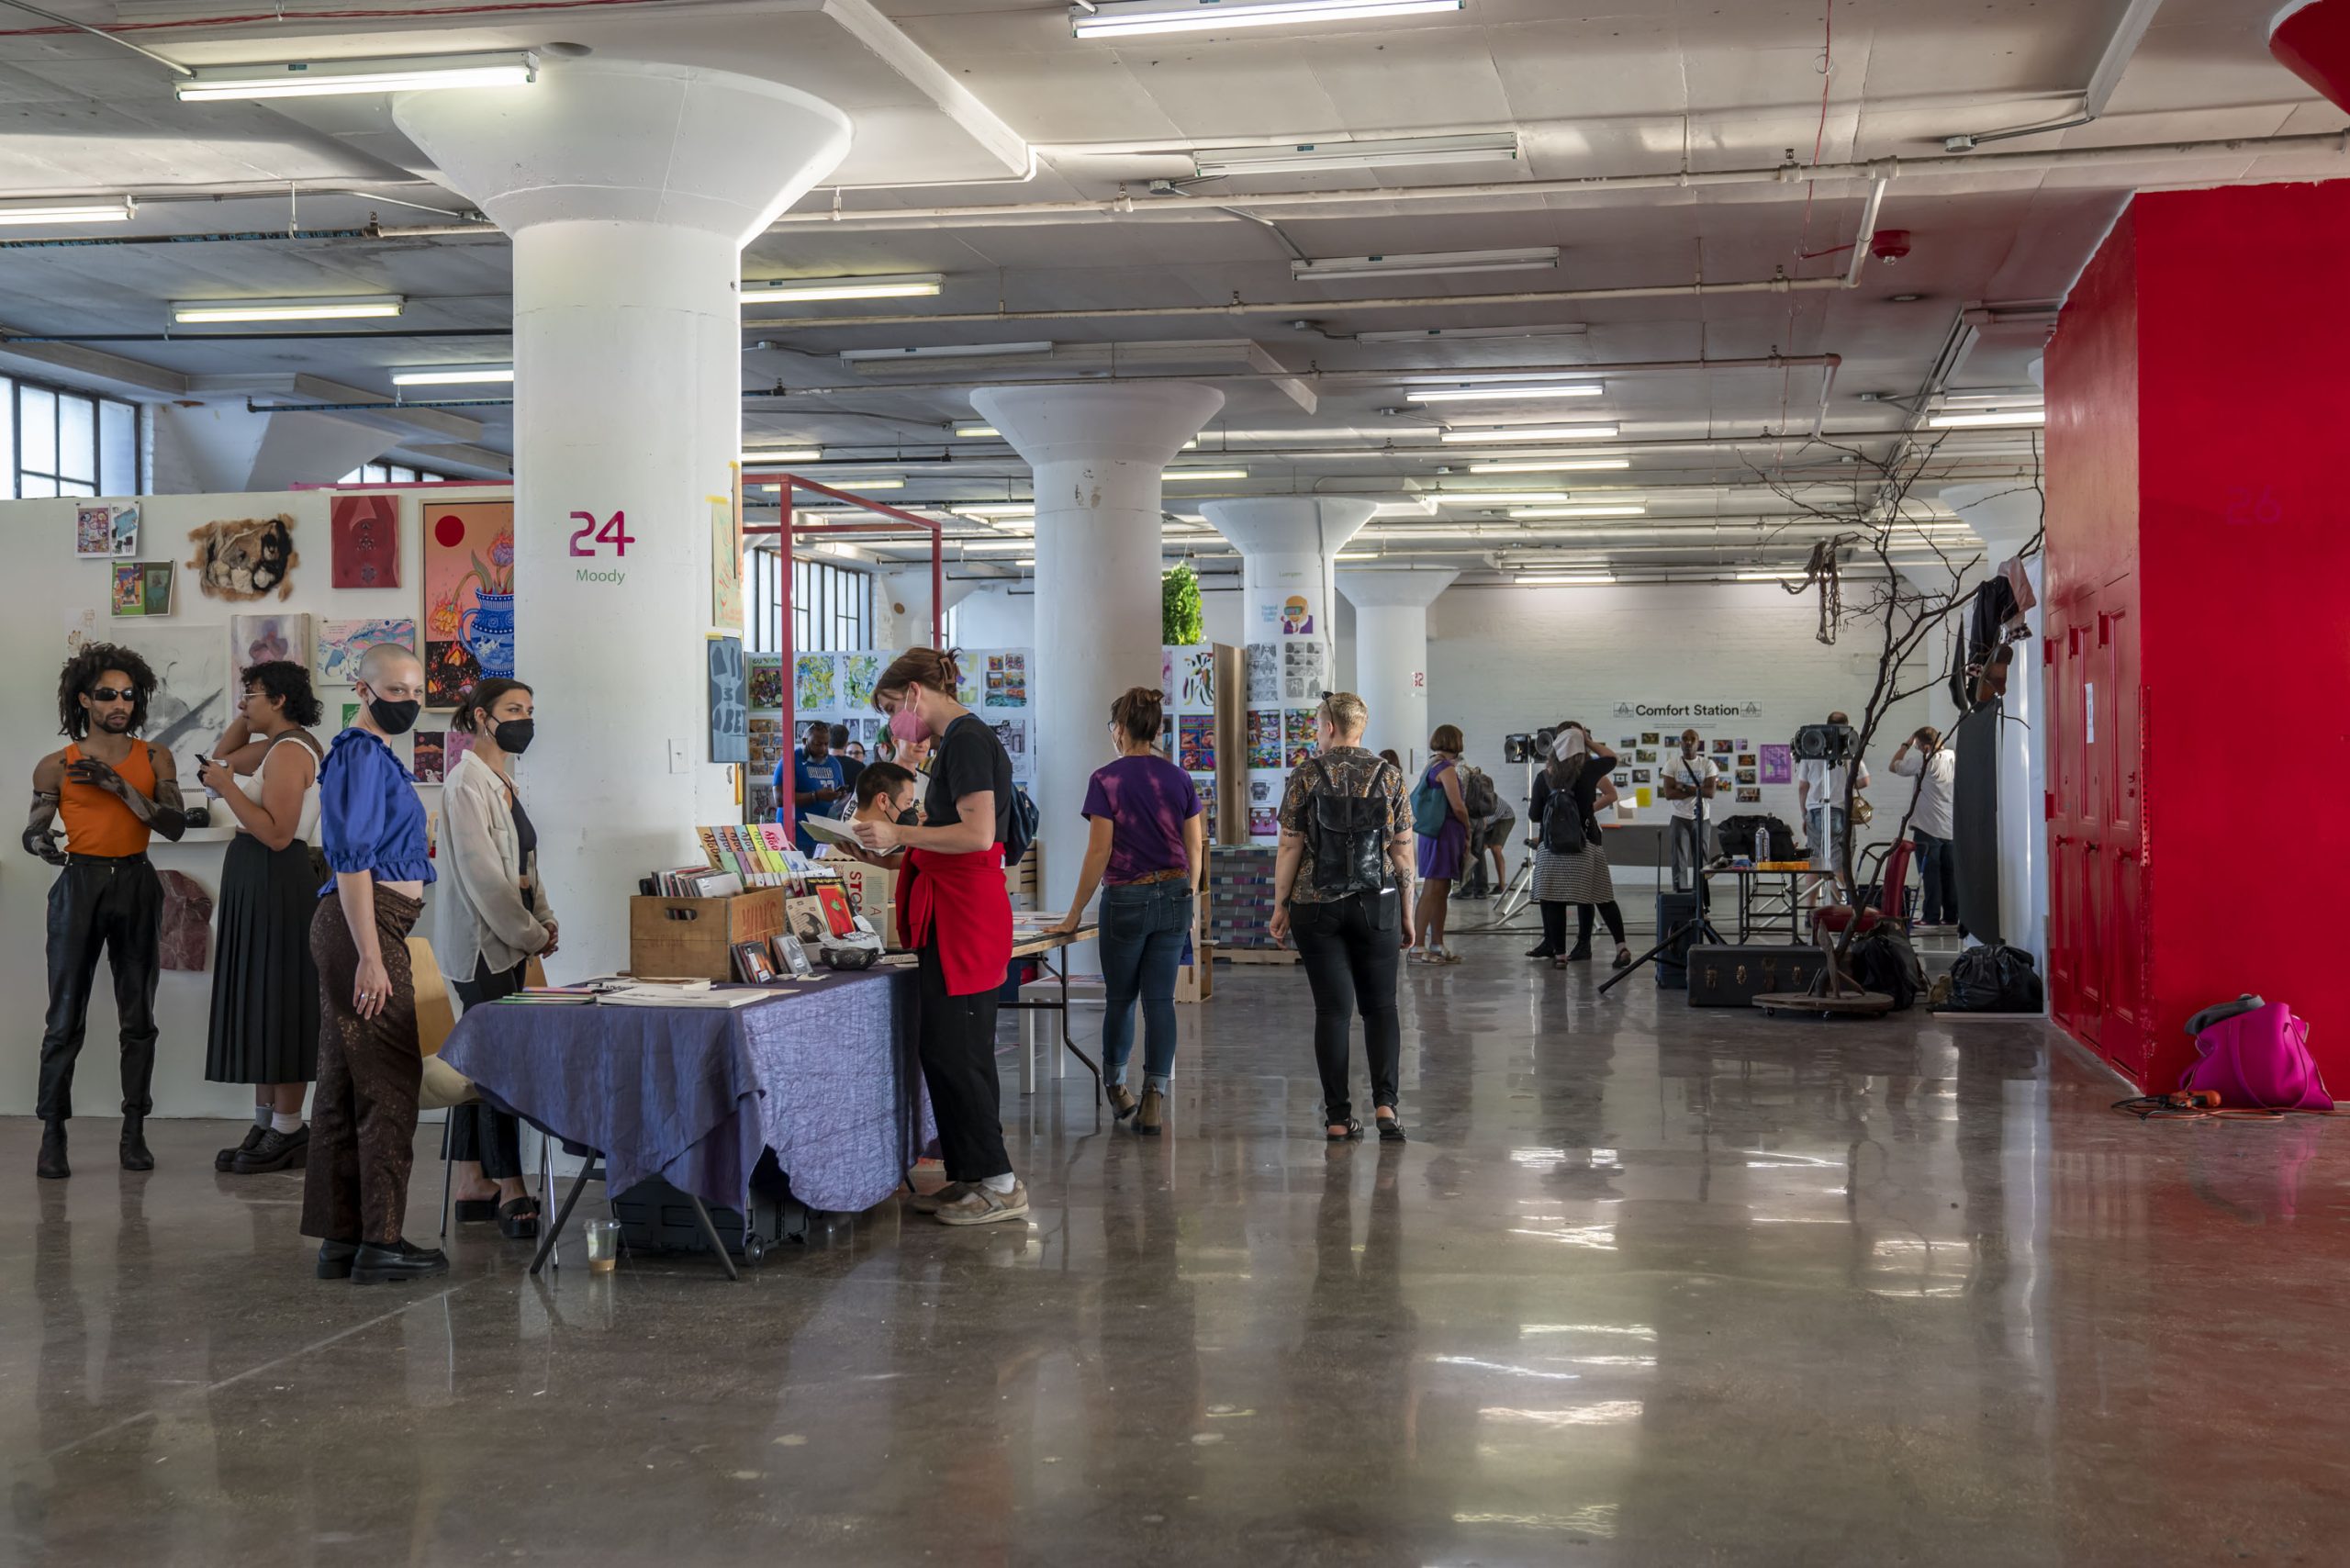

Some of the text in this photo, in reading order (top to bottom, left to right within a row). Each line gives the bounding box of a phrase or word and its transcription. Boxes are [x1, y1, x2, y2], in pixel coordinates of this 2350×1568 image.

[2227, 485, 2282, 524] 26
[569, 510, 635, 556] 24
[576, 568, 625, 586] Moody
[1635, 704, 1740, 716] Comfort Station
